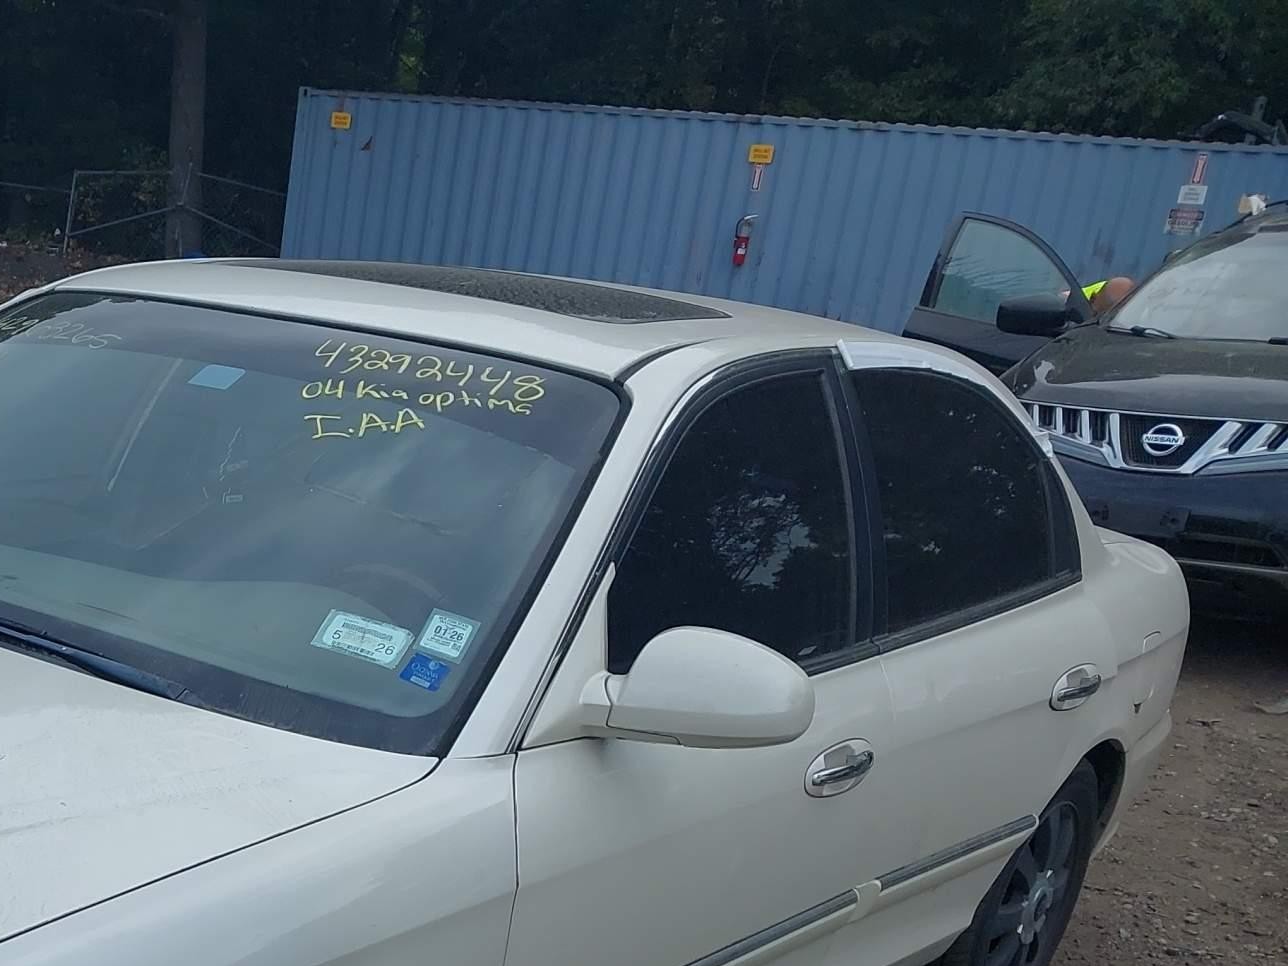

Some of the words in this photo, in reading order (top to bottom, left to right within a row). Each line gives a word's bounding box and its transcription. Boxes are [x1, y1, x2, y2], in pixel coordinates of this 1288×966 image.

[315, 338, 546, 402] 43292448
[301, 379, 345, 399] 04
[1144, 435, 1180, 443] NISSAN
[332, 630, 343, 641] 5
[374, 643, 396, 656] 26
